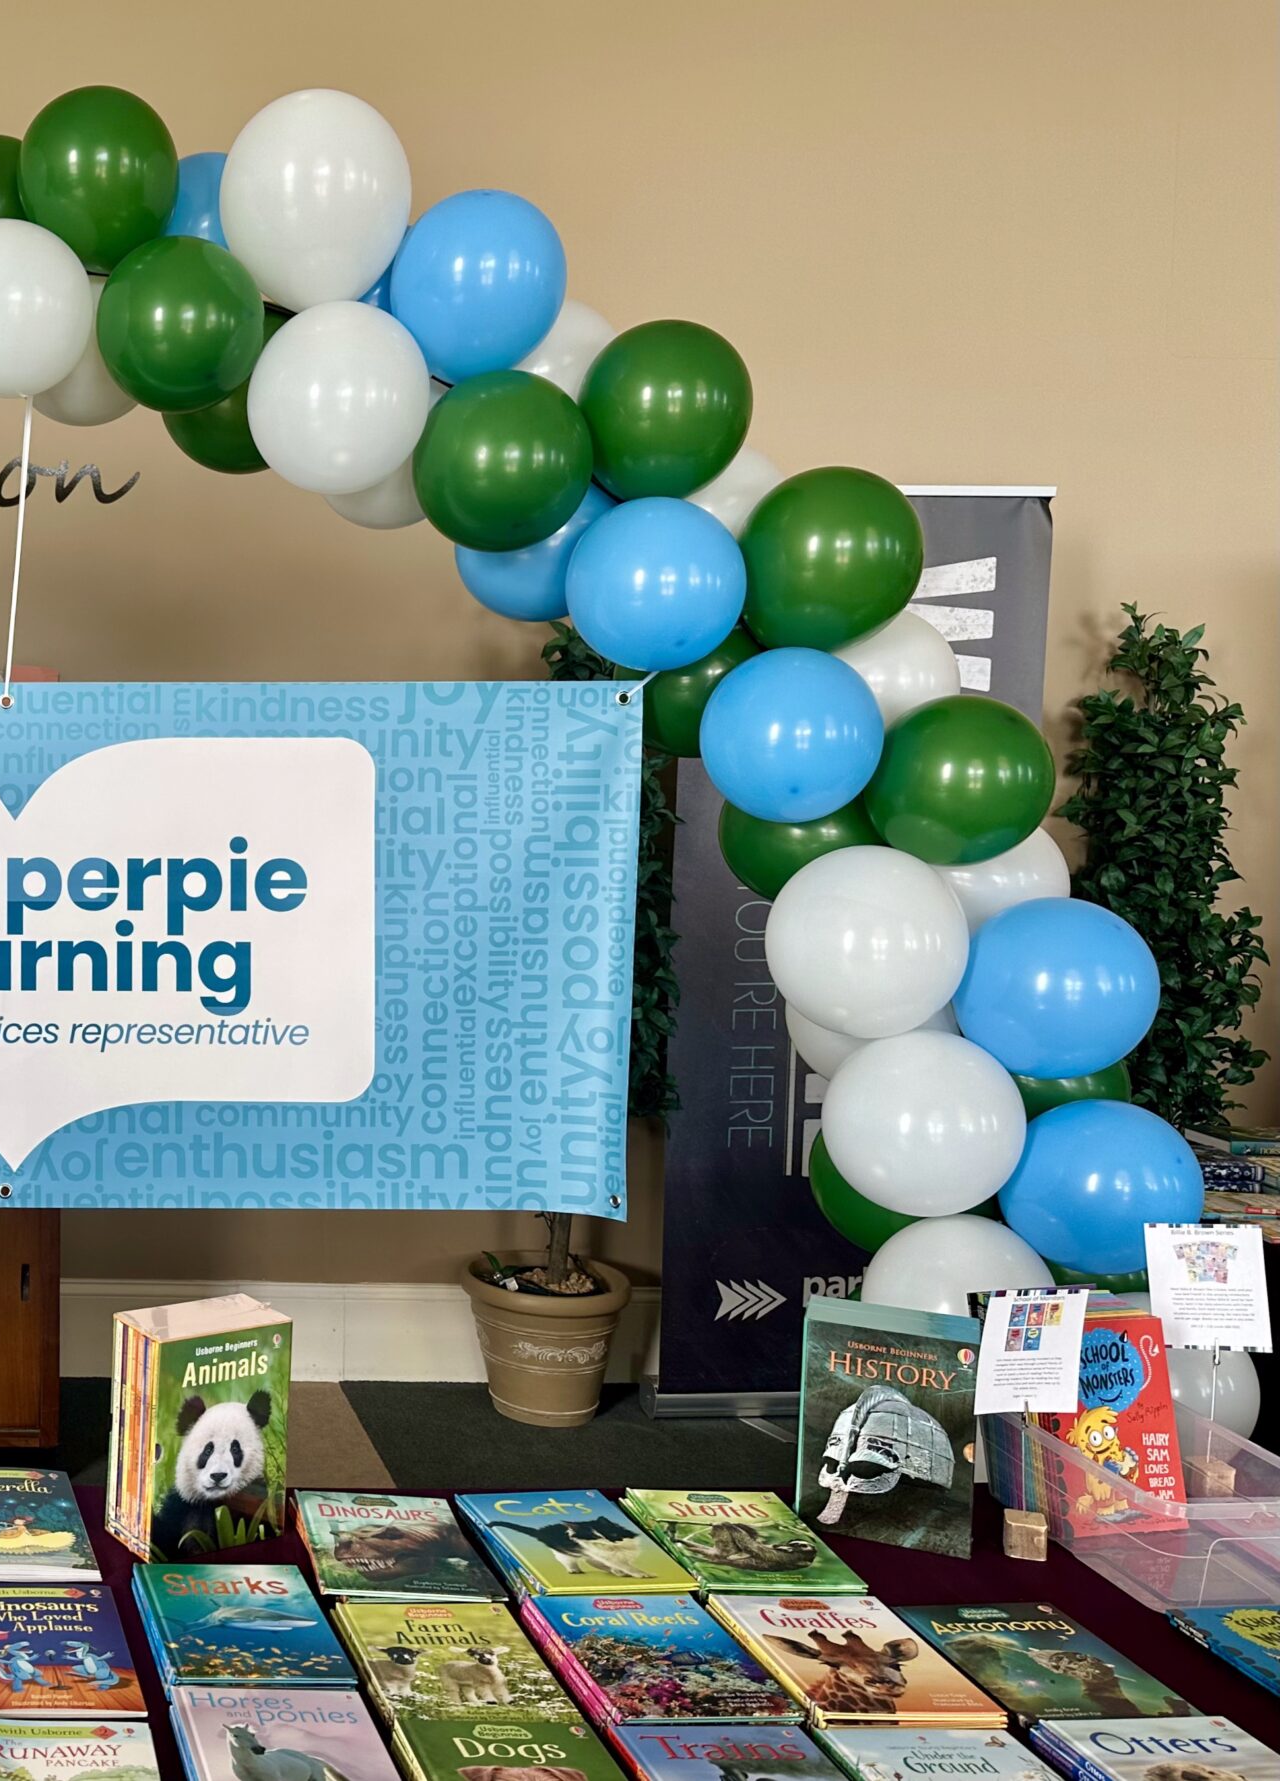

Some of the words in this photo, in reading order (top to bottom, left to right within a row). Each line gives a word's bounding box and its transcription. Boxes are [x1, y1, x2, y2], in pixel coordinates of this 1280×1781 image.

[196, 684, 390, 722] kindness
[504, 688, 531, 826] kindness
[484, 730, 501, 824] influential
[551, 707, 618, 1010] possibility
[445, 774, 488, 1007] exceptional
[478, 829, 519, 1013] possibility
[383, 883, 417, 1064] kindness
[414, 891, 449, 1134] connection
[70, 1018, 310, 1053] representative
[453, 1009, 476, 1140] influential
[727, 1045, 776, 1148] HERE
[195, 1097, 414, 1137] community
[115, 1130, 469, 1180] enthusiasm
[803, 1268, 868, 1307] par
[196, 1344, 223, 1357] Usborne
[225, 1338, 258, 1352] Beginners
[1080, 1342, 1129, 1369] SCHOOL
[182, 1351, 268, 1388] Animals
[829, 1351, 957, 1391] HISTORY
[1101, 1361, 1111, 1371] of
[1079, 1367, 1136, 1399] MONSTERS
[1142, 1433, 1169, 1446] HAIRY
[1147, 1448, 1170, 1461] SAM
[1144, 1465, 1169, 1474] LOVES
[1149, 1477, 1175, 1487] BREAD
[318, 1503, 438, 1522] DINOSAURS
[494, 1498, 593, 1516] Cats
[668, 1501, 769, 1519] SLOTHS
[162, 1573, 288, 1596] Sharks
[13, 1621, 93, 1634] Applause
[32, 1612, 83, 1622] Loved
[404, 1619, 465, 1632] Farm
[561, 1612, 628, 1627] Coral
[630, 1611, 700, 1626] Reefs
[760, 1608, 878, 1630] Giraffes
[930, 1618, 1076, 1636] Astronomy
[396, 1631, 491, 1645] Animals
[189, 1692, 294, 1709] Horses
[226, 1710, 251, 1718] and
[256, 1708, 358, 1726] ponies
[32, 1725, 83, 1737] Usborne
[453, 1737, 566, 1764] Dogs
[639, 1735, 806, 1761] Trains
[1089, 1731, 1237, 1755] Otters
[45, 1758, 119, 1768] PANCAKE
[903, 1756, 1000, 1774] Ground
[911, 1750, 954, 1761] Under
